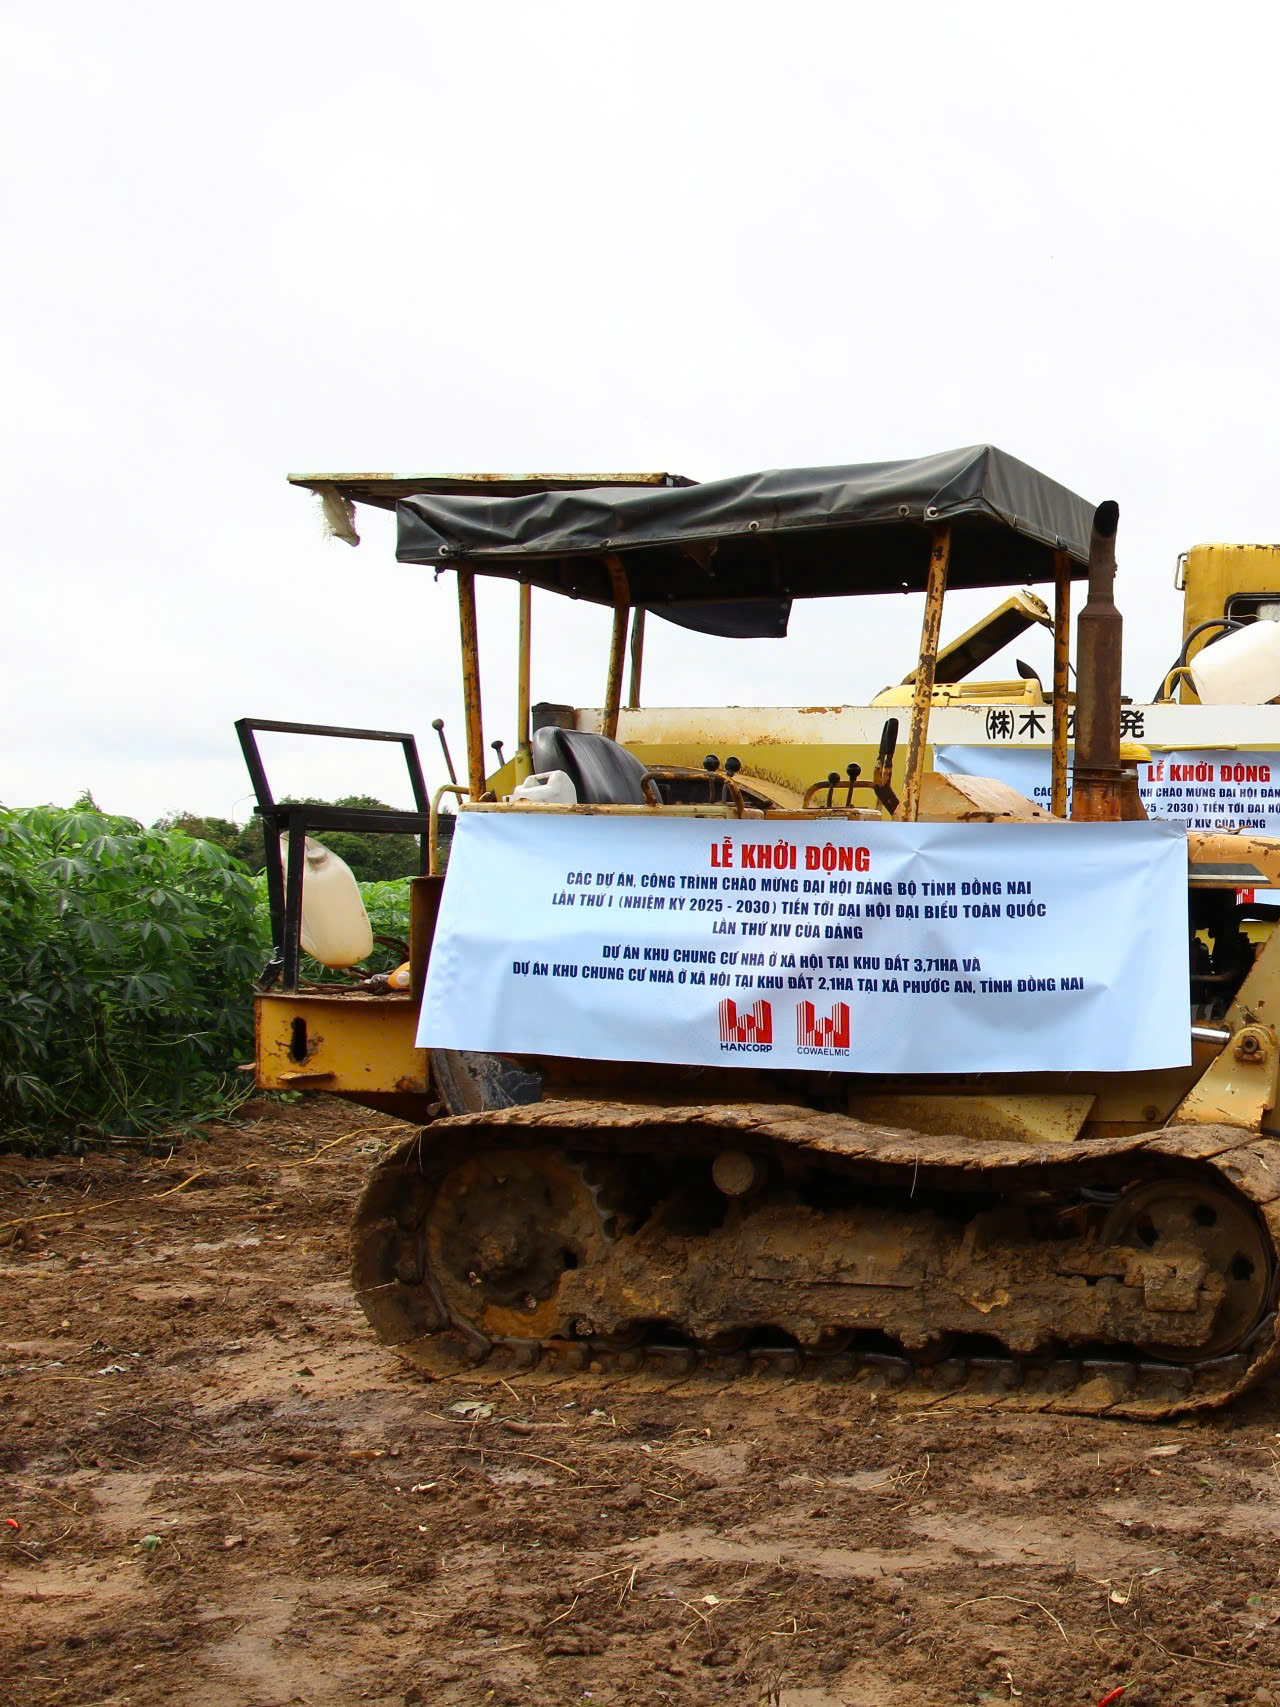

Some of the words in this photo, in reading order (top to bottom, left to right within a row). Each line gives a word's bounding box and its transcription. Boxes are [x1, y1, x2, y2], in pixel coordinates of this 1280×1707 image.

[1148, 760, 1164, 782] LỄ
[1170, 760, 1214, 782] KHỞI
[1221, 762, 1271, 786] ĐỘNG
[1155, 786, 1182, 797] CHÀO
[1186, 786, 1216, 798] MỪNG
[1219, 788, 1236, 800] ĐẠI
[1239, 787, 1258, 800] HỘI
[1203, 801, 1225, 813] TIẾN
[1229, 802, 1245, 813] TỚI
[1247, 803, 1264, 815] ĐẠI
[1195, 818, 1212, 829] XIV
[711, 836, 734, 868] LỄ
[741, 839, 797, 870] KHỞI
[805, 842, 870, 875] ĐỘNG
[566, 872, 592, 886] CÁC
[596, 872, 616, 889] DỰ
[617, 873, 637, 889] ÁN,
[641, 873, 676, 889] CÔNG
[680, 874, 718, 890] TRÌNH
[722, 875, 756, 891] CHÀO
[761, 876, 798, 893] MỪNG
[803, 879, 825, 897] ĐẠI
[829, 878, 852, 897] HỘI
[856, 878, 893, 896] ĐẢNG
[897, 880, 917, 898] BỘ
[922, 879, 956, 896] TỈNH
[961, 877, 1002, 896] ĐỒNG
[1007, 881, 1032, 895] NAI
[552, 891, 575, 906] LẦN
[580, 893, 605, 907] THỨ
[607, 895, 614, 907] I
[669, 895, 686, 911] KỲ
[689, 897, 723, 912] 2025
[781, 898, 808, 915] TIẾN
[813, 900, 834, 916] TỚI
[838, 904, 860, 919] ĐẠI
[865, 902, 891, 920] HỘI
[895, 904, 919, 920] ĐẠI
[924, 900, 958, 918] BIỂU
[963, 902, 1001, 918] TOÀN
[1006, 899, 1047, 918] QUỐC
[712, 917, 736, 934] LẦN
[741, 921, 768, 936] THỨ
[770, 922, 791, 937] XIV
[795, 921, 820, 938] CỦA
[825, 922, 863, 939] ĐẢNG
[602, 944, 621, 961] DỰ
[623, 945, 639, 960] ÁN
[643, 947, 669, 962] KHU
[673, 949, 716, 964] CHUNG
[720, 950, 739, 965] CƯ
[741, 950, 765, 967] NHÀ
[769, 949, 779, 967] Ở
[780, 951, 796, 968] XÃ
[800, 953, 823, 971] HỘI
[827, 955, 849, 972] TẠI
[853, 956, 880, 970] KHU
[884, 954, 910, 971] ĐẤT
[913, 958, 958, 974] 3,71HA
[962, 957, 981, 972] VÀ
[513, 961, 531, 977] DỰ
[533, 961, 549, 976] ÁN
[552, 963, 578, 978] KHU
[581, 966, 624, 981] CHUNG
[628, 967, 648, 982] CƯ
[649, 968, 674, 984] NHÀ
[678, 967, 688, 985] Ở
[690, 969, 706, 985] XÃ
[709, 970, 731, 989] HỘI
[735, 973, 754, 991] TẠI
[757, 976, 784, 990] KHU
[788, 973, 814, 990] ĐẤT
[818, 977, 854, 992] 2,1HA
[858, 978, 878, 995] TẠI
[882, 977, 899, 993] XÃ
[903, 976, 950, 993] PHƯỚC
[954, 980, 976, 995] AN,
[980, 976, 1013, 993] TỈNH
[1017, 974, 1056, 992] ĐỒNG
[1060, 977, 1084, 991] NAI
[720, 1043, 773, 1053] HANCORP
[797, 1047, 850, 1057] COWAELMIC
